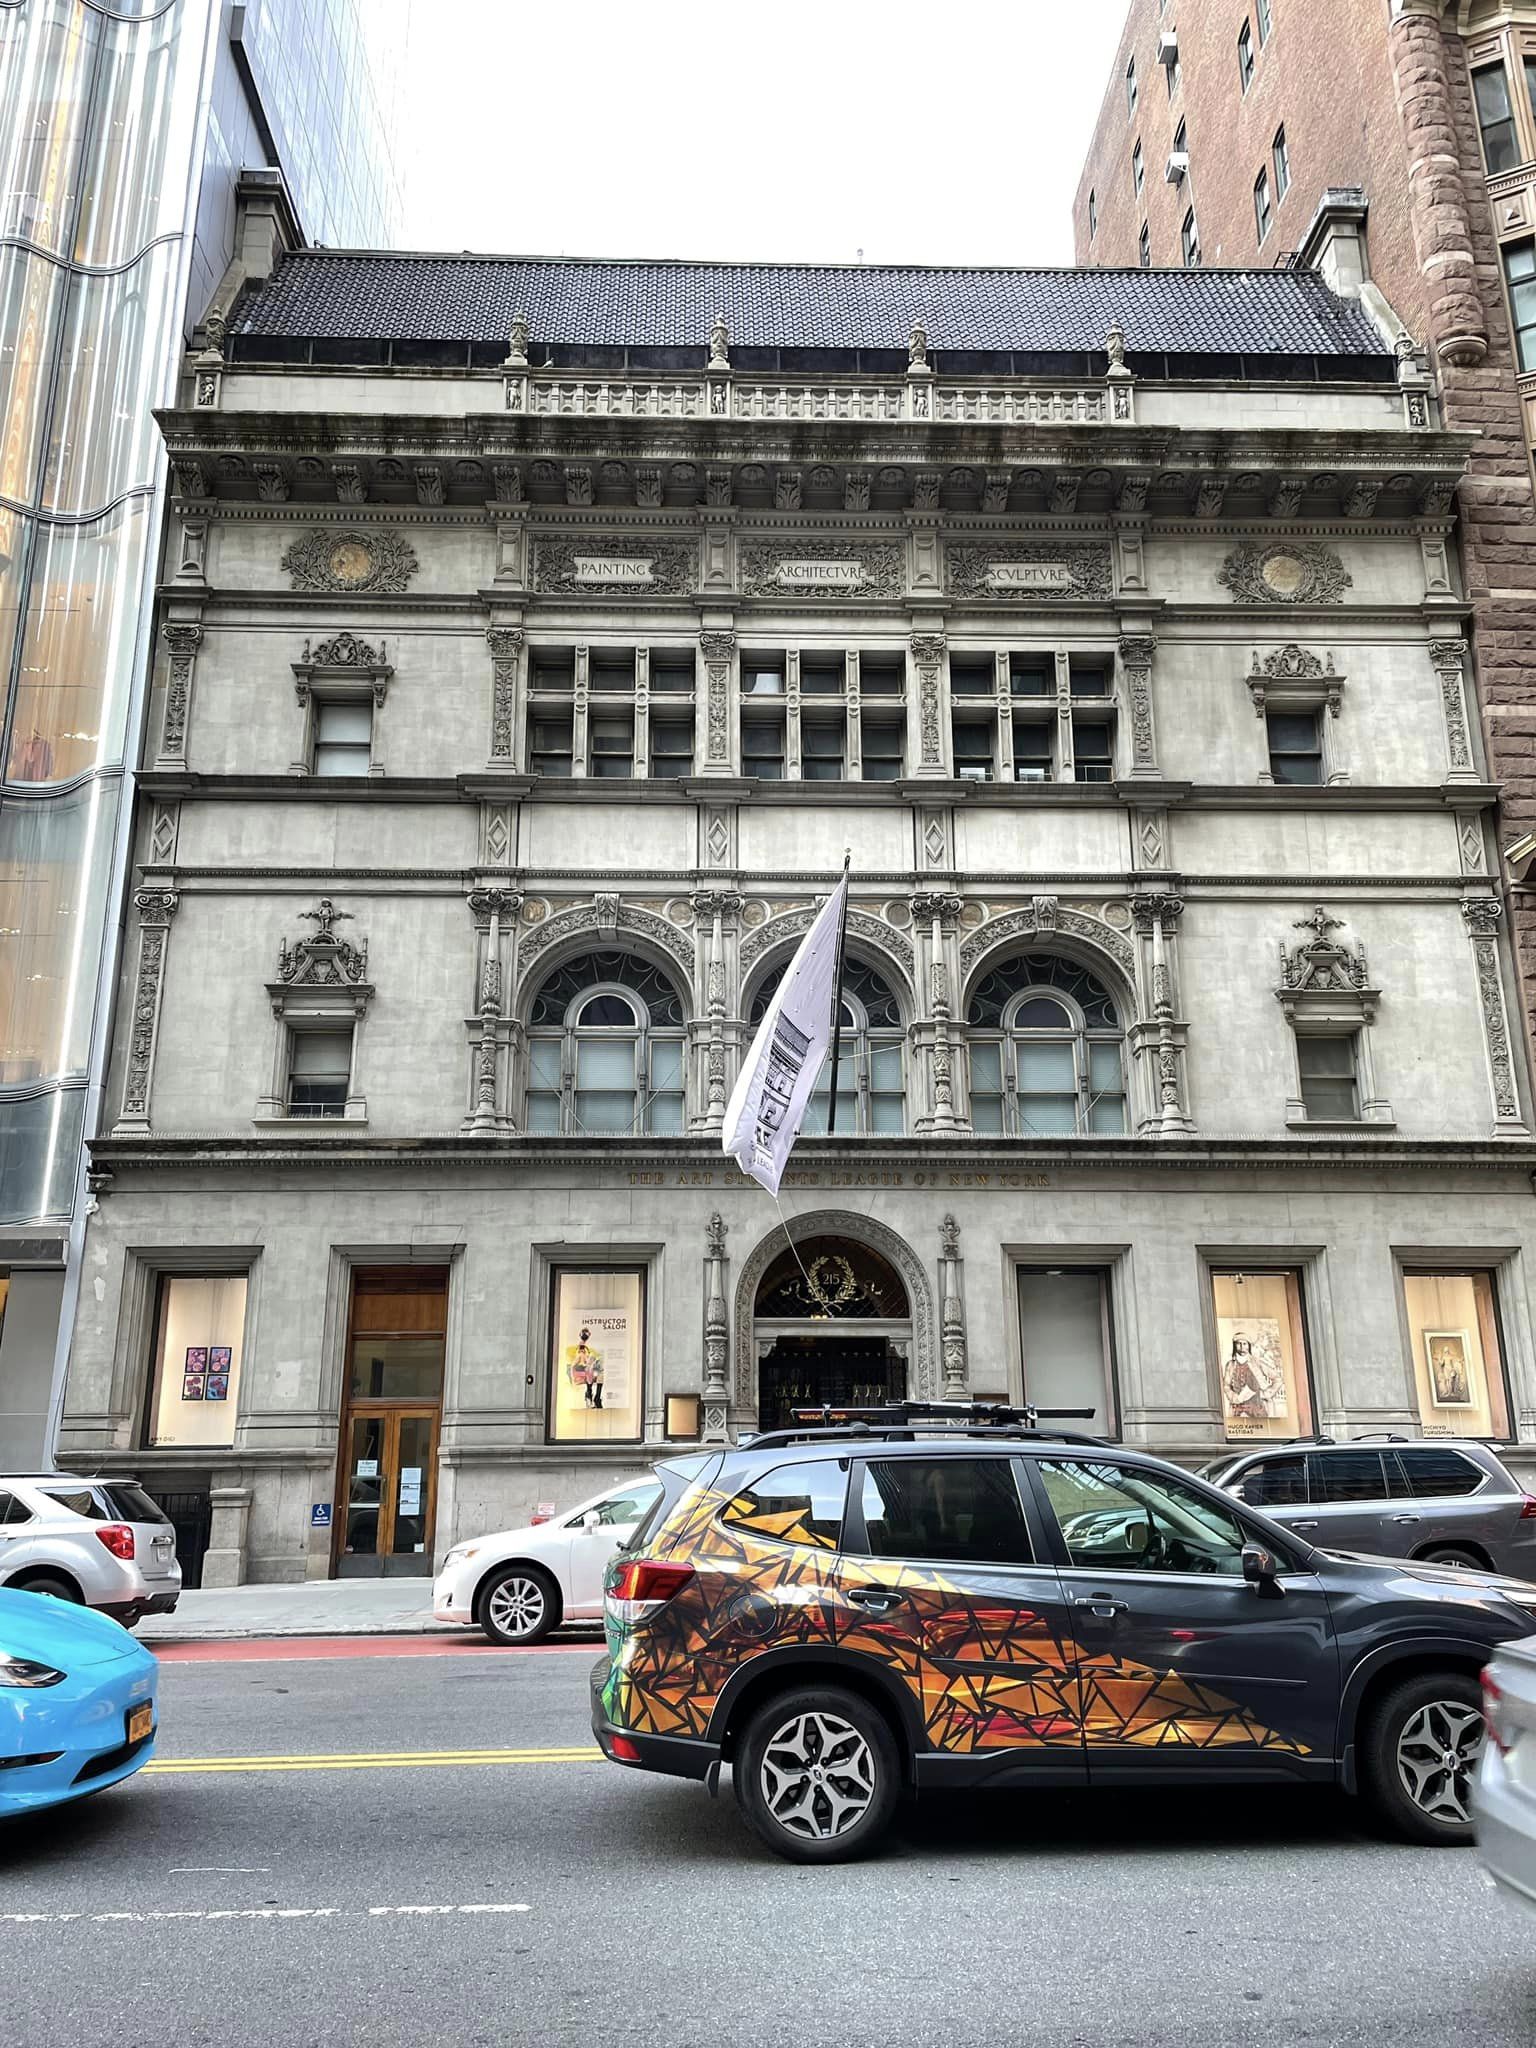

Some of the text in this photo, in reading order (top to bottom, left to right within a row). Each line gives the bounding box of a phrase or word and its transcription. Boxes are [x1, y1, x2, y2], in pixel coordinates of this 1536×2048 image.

[581, 563, 646, 576] PAINTING
[775, 566, 865, 579] ARCHITECTVRE
[990, 568, 1065, 581] SCVLPTVRE
[629, 1172, 665, 1185] THE
[678, 1172, 713, 1185] ART
[831, 1172, 903, 1185] LEAGUE
[913, 1172, 939, 1185] OF
[949, 1173, 991, 1185] NEW
[999, 1173, 1049, 1186] YORK
[822, 1273, 840, 1285] 215
[582, 1318, 627, 1326] INSTRUCTOR
